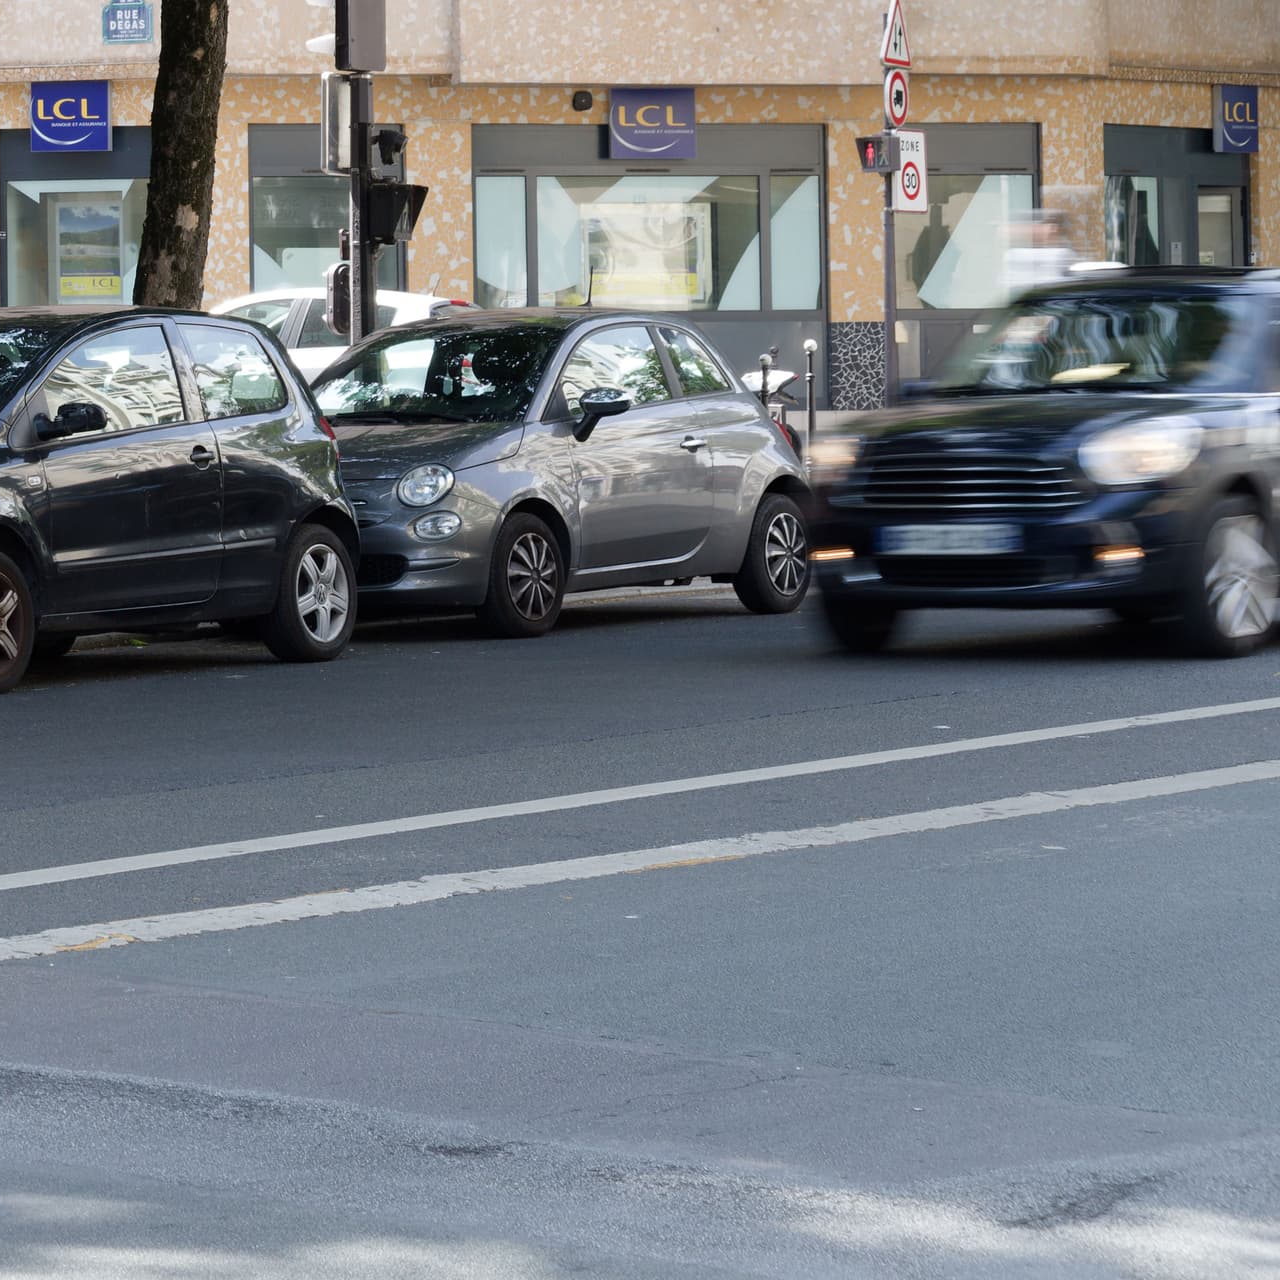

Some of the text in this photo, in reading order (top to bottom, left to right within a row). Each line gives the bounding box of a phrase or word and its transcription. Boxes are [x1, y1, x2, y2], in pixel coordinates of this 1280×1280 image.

[117, 10, 138, 20] RUE
[110, 20, 145, 30] DEGAS
[37, 98, 100, 120] LCL
[618, 105, 682, 127] LCL
[1224, 101, 1255, 122] LCL
[901, 140, 920, 152] ZONE
[905, 173, 917, 189] 30
